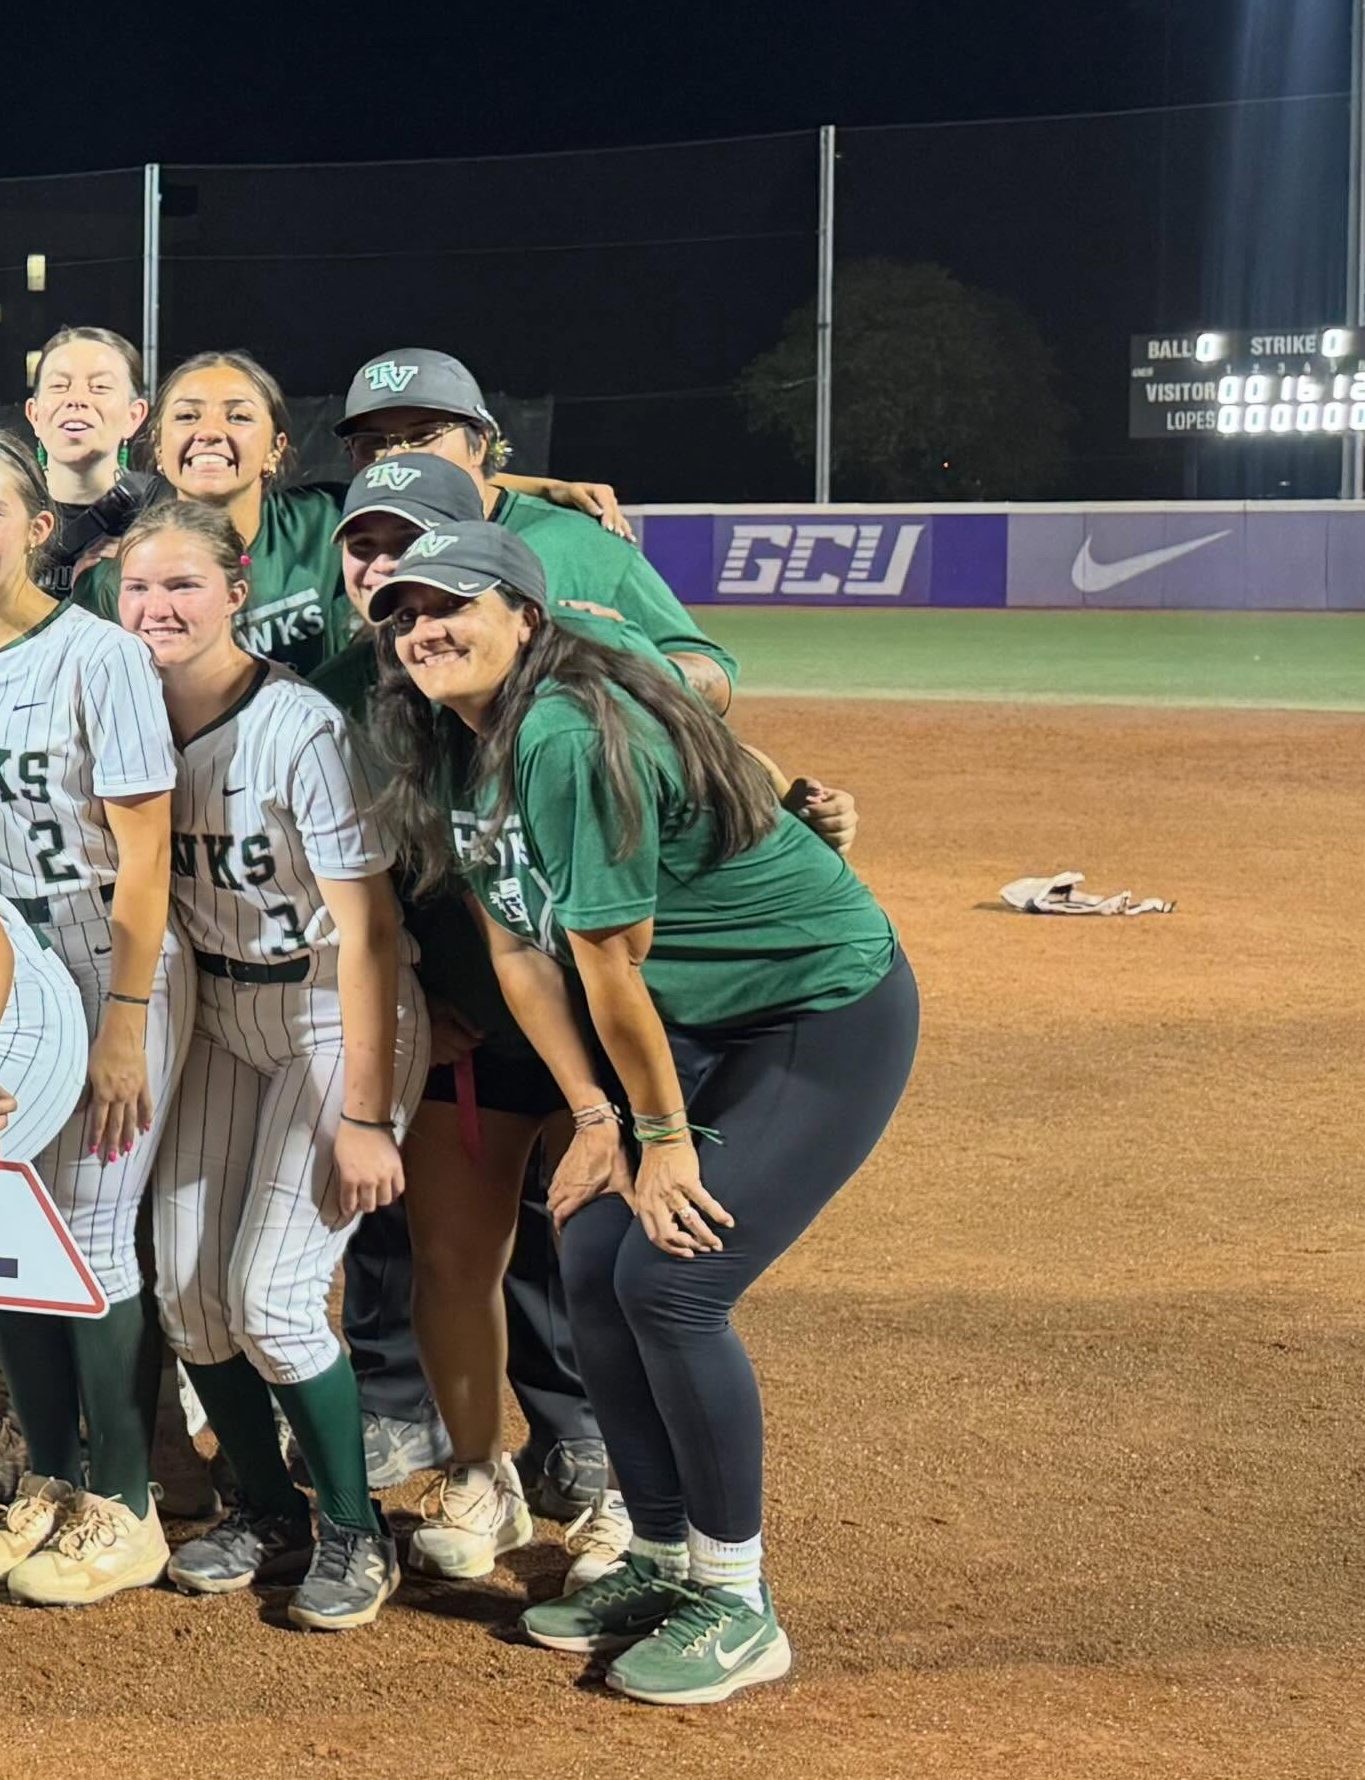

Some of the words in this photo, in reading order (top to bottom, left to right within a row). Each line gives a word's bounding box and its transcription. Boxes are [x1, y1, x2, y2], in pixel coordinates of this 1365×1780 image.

[1148, 339, 1191, 359] BALL
[1195, 332, 1221, 362] 0
[1250, 334, 1317, 356] STRIKE
[1322, 328, 1349, 358] 0
[365, 361, 418, 392] TV
[1146, 381, 1216, 403] VISITOR
[1218, 375, 1241, 405] 0
[1245, 374, 1269, 404] 0
[1166, 410, 1216, 431] LOPES
[1217, 404, 1240, 434] 0
[1244, 403, 1269, 433] 0
[1270, 403, 1294, 433] 0
[1296, 403, 1320, 433] 0
[1322, 402, 1346, 432] 0
[365, 461, 421, 491] TV
[717, 523, 925, 596] GCU
[236, 604, 325, 655] WKS
[28, 819, 81, 884] 2
[171, 833, 276, 892] WKS
